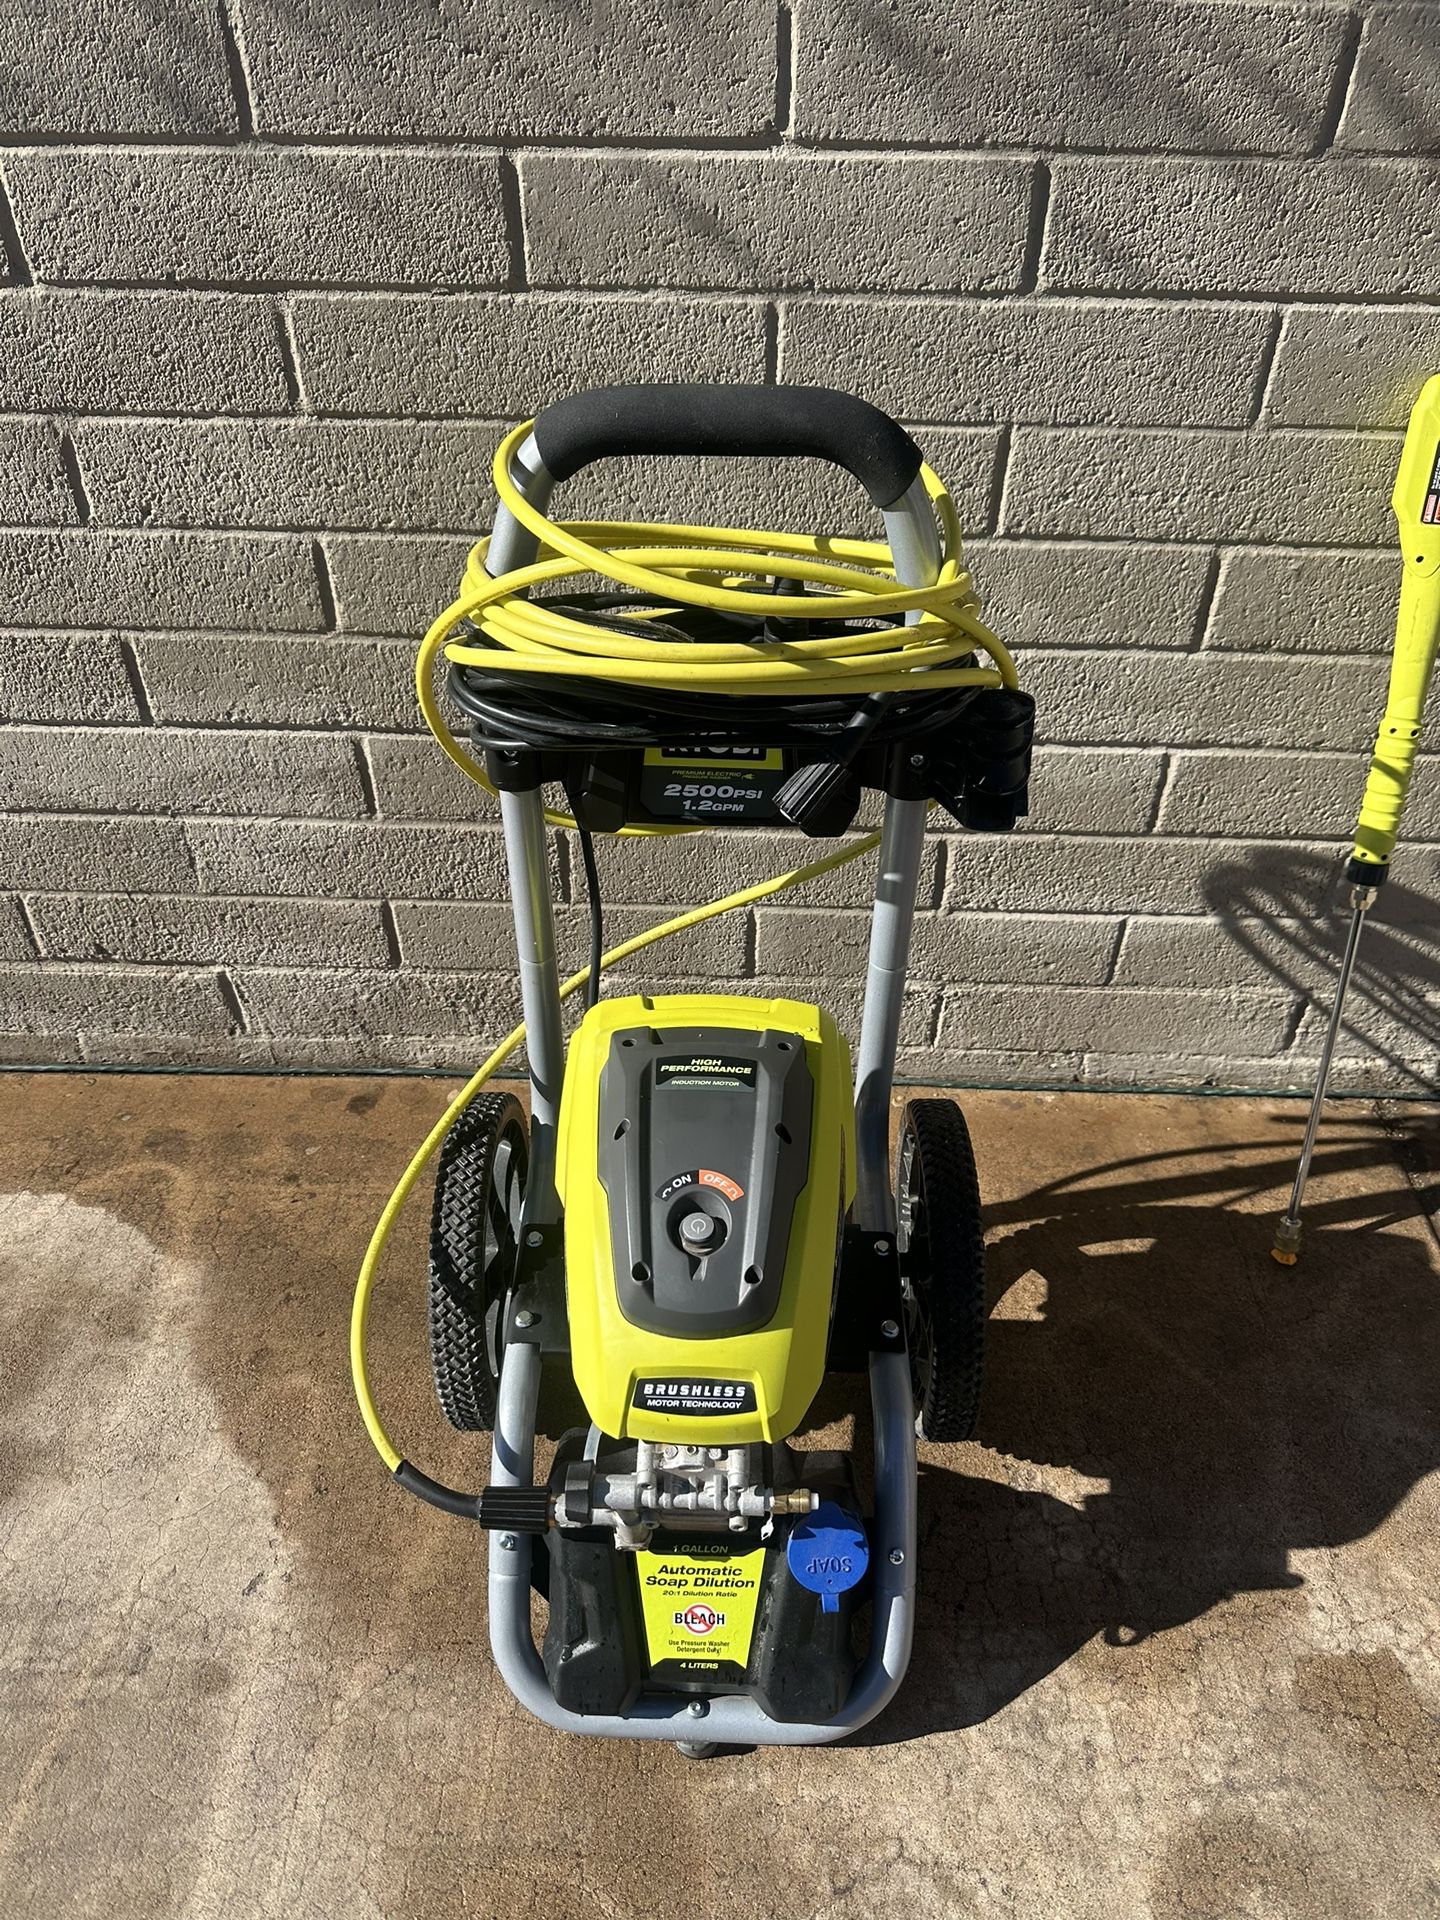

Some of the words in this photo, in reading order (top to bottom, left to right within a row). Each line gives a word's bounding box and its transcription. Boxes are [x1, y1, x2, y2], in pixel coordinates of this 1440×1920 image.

[663, 783, 764, 799] 2500PSI
[682, 799, 745, 812] 1.2GPM
[690, 1058, 722, 1066] HIGH
[660, 1065, 753, 1075] PERFORMANCE
[672, 1174, 692, 1188] ON
[704, 1173, 729, 1188] OFF
[643, 1383, 746, 1397] BRUSHLESS
[646, 1399, 680, 1407] MOTOR
[681, 1400, 742, 1409] TECHNOLOGY
[673, 1544, 679, 1553] 1
[681, 1544, 729, 1554] GALLON
[658, 1564, 743, 1576] Automatic
[806, 1555, 852, 1575] SOAP
[645, 1575, 689, 1589] Soap
[693, 1576, 755, 1588] Dilution
[662, 1589, 681, 1597] 20:1
[674, 1612, 725, 1625] BLEACH
[680, 1639, 707, 1647] Pressure
[676, 1646, 706, 1654] Detergent
